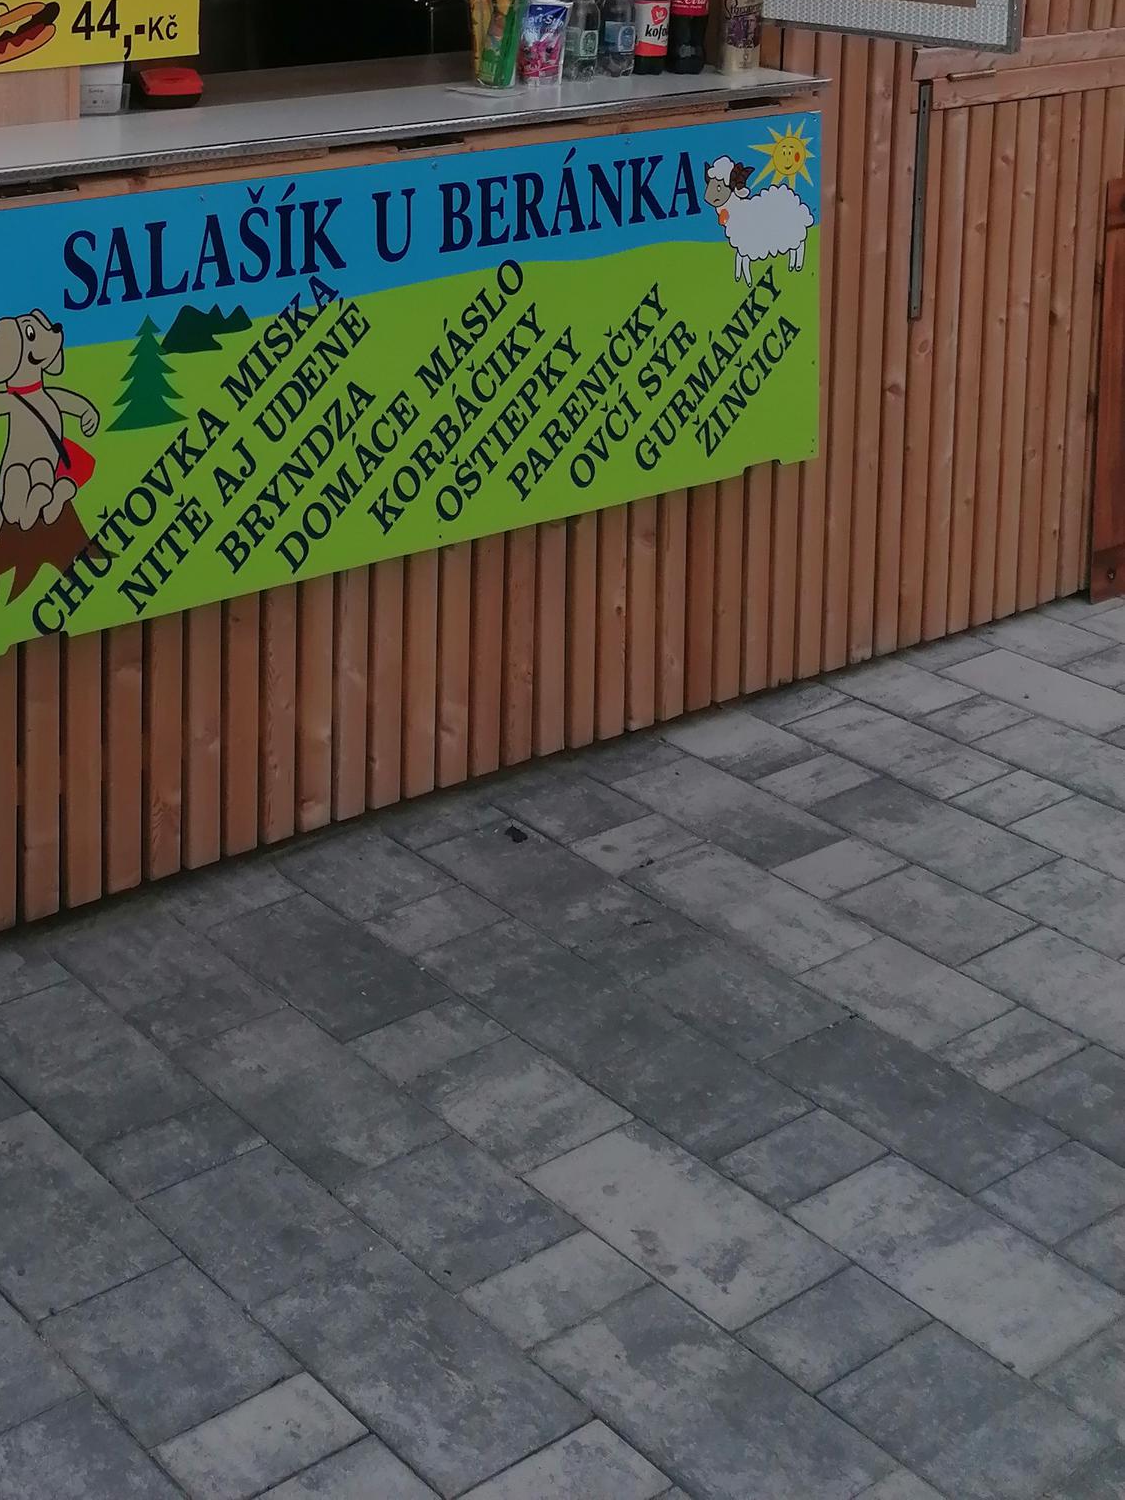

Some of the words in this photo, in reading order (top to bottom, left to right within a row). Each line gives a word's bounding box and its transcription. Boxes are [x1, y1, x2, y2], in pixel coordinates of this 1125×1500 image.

[63, 182, 347, 311] SALAŠÍK
[372, 188, 416, 263] U
[439, 147, 701, 254] BERÁNKA
[32, 407, 230, 636] CHUŤOVKA
[220, 275, 340, 411] MISKA
[117, 493, 214, 615] NITĚ
[212, 437, 258, 507] AJ
[253, 298, 372, 443] UDENÉ
[275, 390, 420, 575] DOMÁCE
[413, 259, 524, 399] MÁSLO
[367, 302, 547, 535] KORBÁČIKY
[435, 325, 582, 521] OŠTIEPKY
[506, 282, 669, 502] PARENIČKY
[569, 382, 643, 489] OVČÍ
[637, 320, 698, 401] SÝR
[635, 264, 782, 472] GURMÁNKY
[692, 315, 802, 458] ŽINČICA
[215, 380, 377, 574] BRYNDZA
